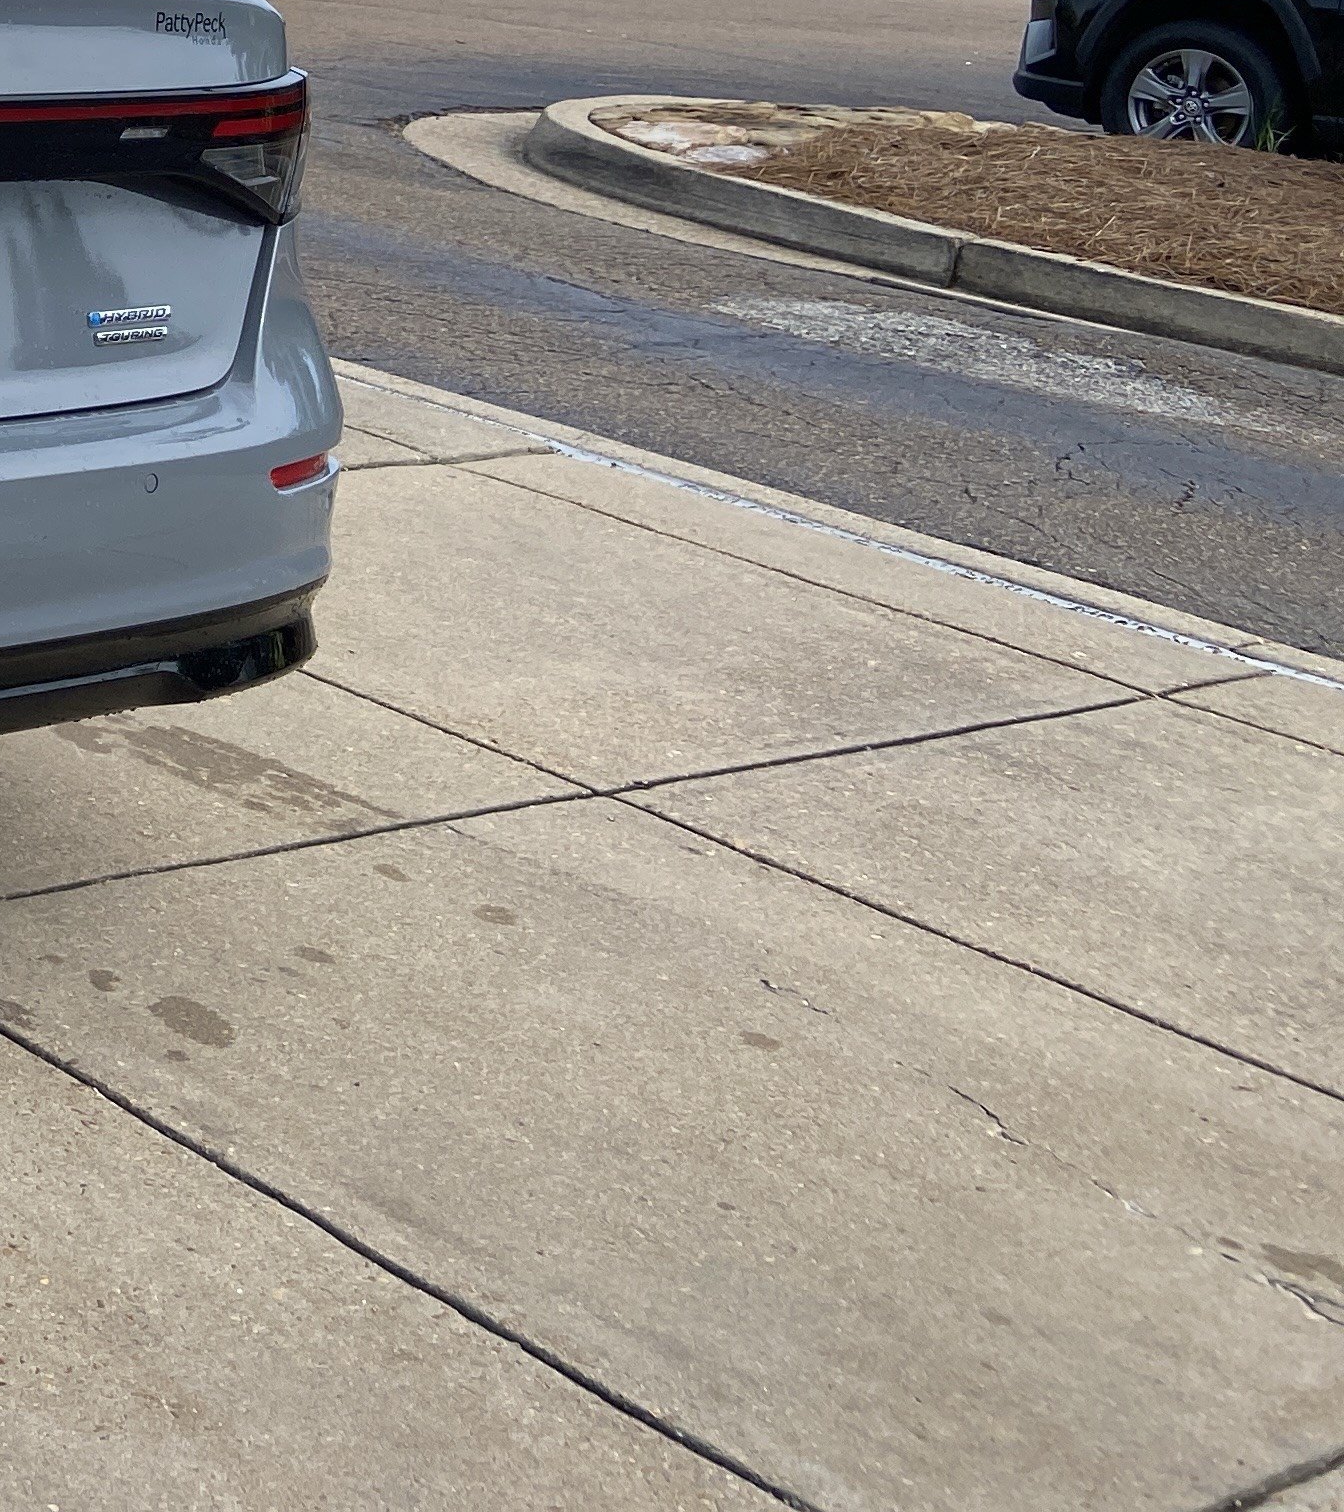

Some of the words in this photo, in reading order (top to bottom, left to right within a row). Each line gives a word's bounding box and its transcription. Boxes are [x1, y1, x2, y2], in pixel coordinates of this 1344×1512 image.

[156, 11, 227, 39] PattyPeck
[100, 308, 167, 324] HYBRID
[99, 329, 164, 342] TOURING
